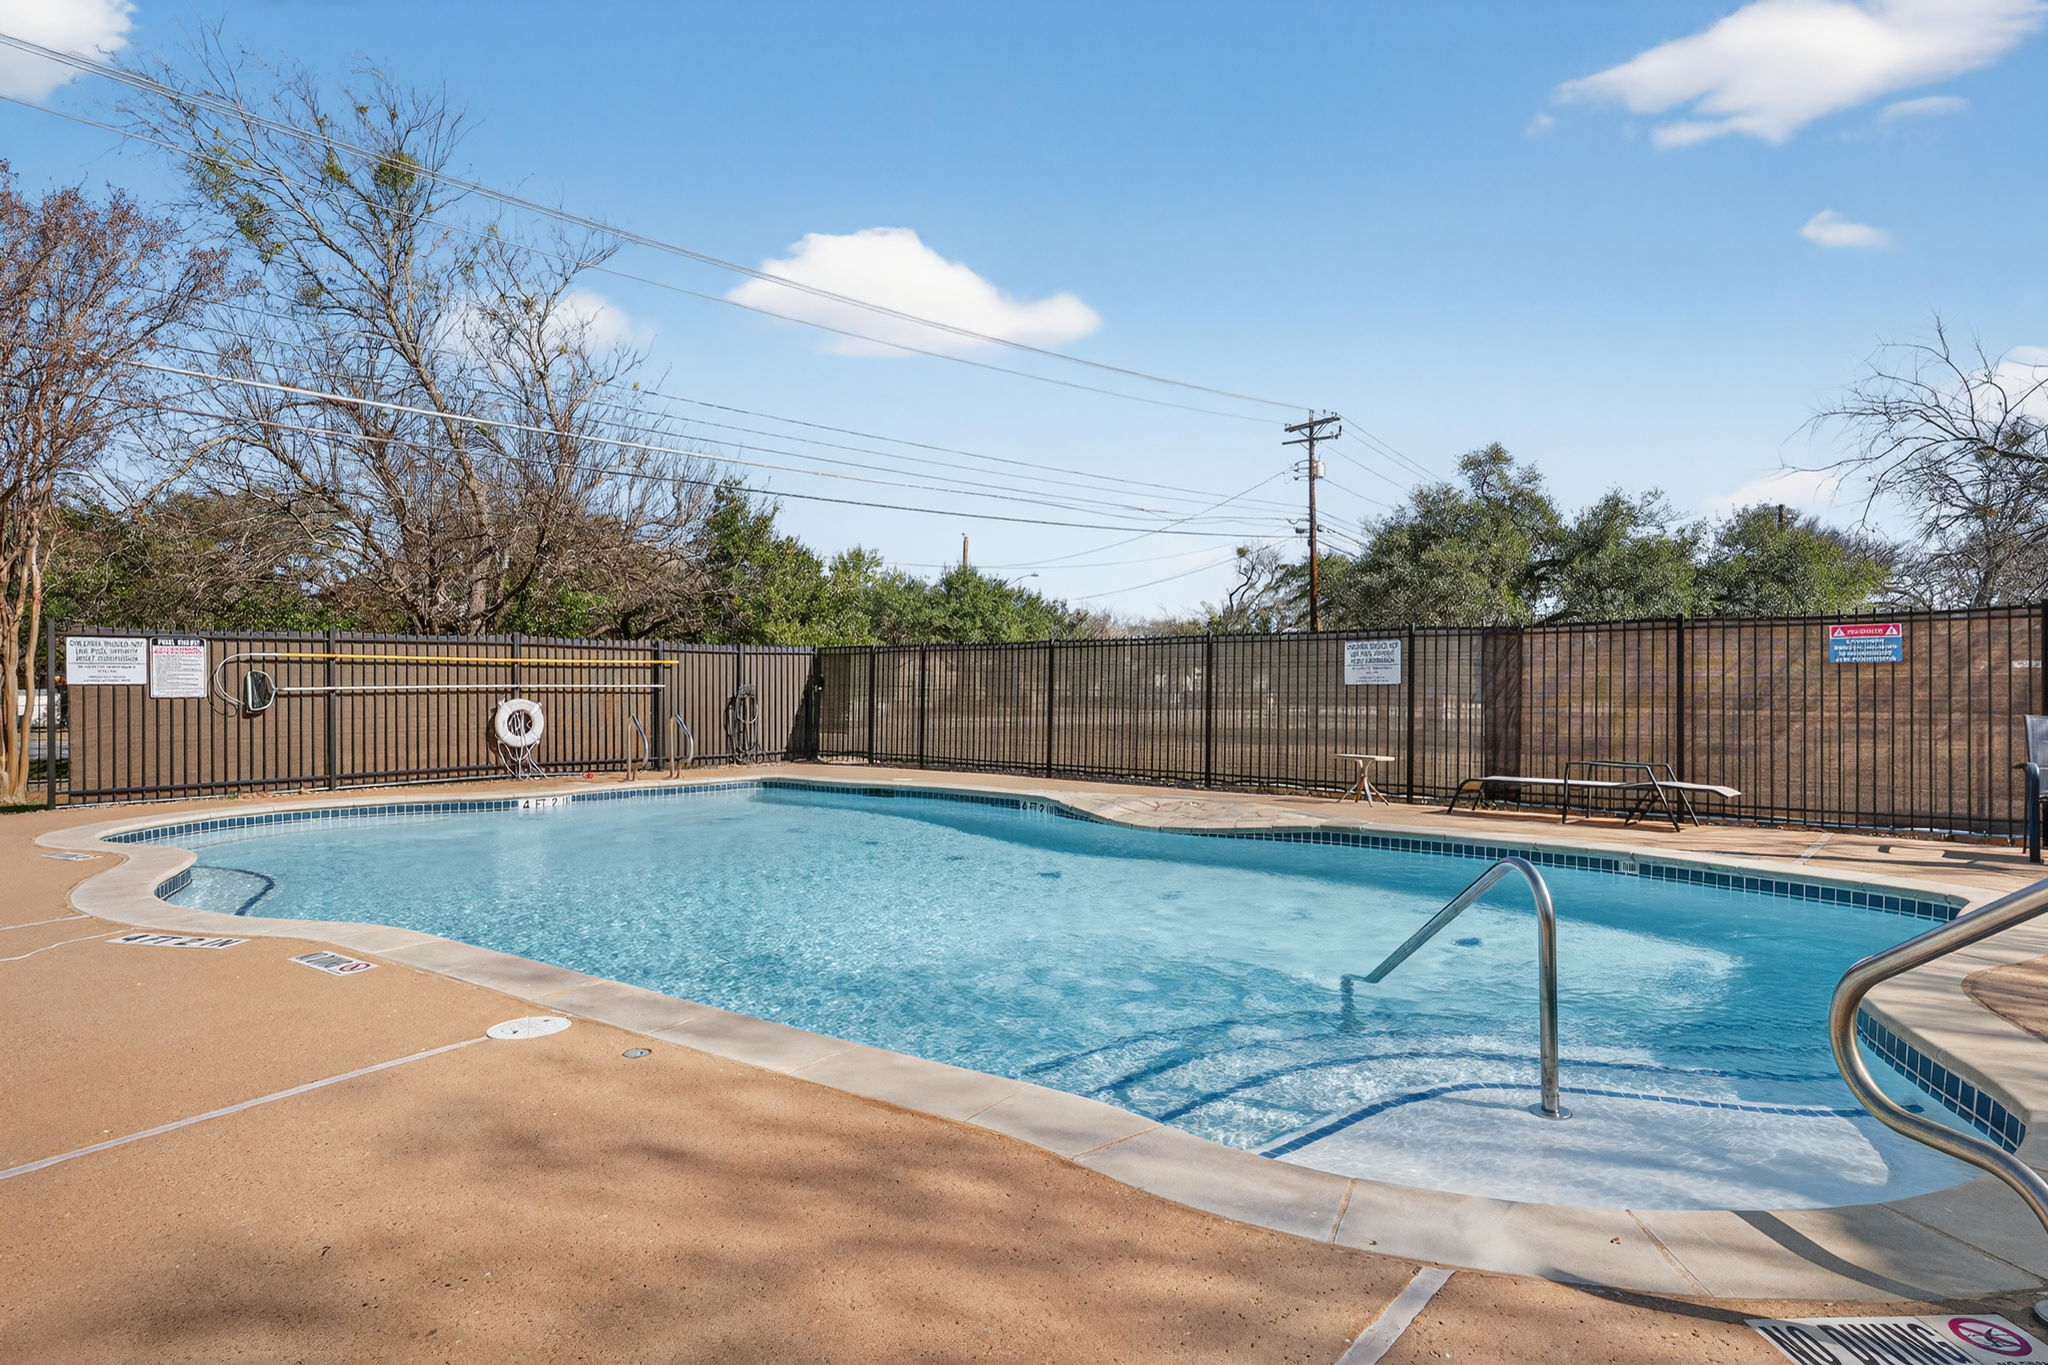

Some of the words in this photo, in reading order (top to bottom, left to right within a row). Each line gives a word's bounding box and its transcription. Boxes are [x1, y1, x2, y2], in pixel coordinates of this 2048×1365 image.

[535, 798, 547, 809] FT
[139, 935, 183, 945] FT
[200, 938, 241, 948] IN
[1758, 1325, 1842, 1365] NO
[1816, 1323, 1974, 1365] DIVING
